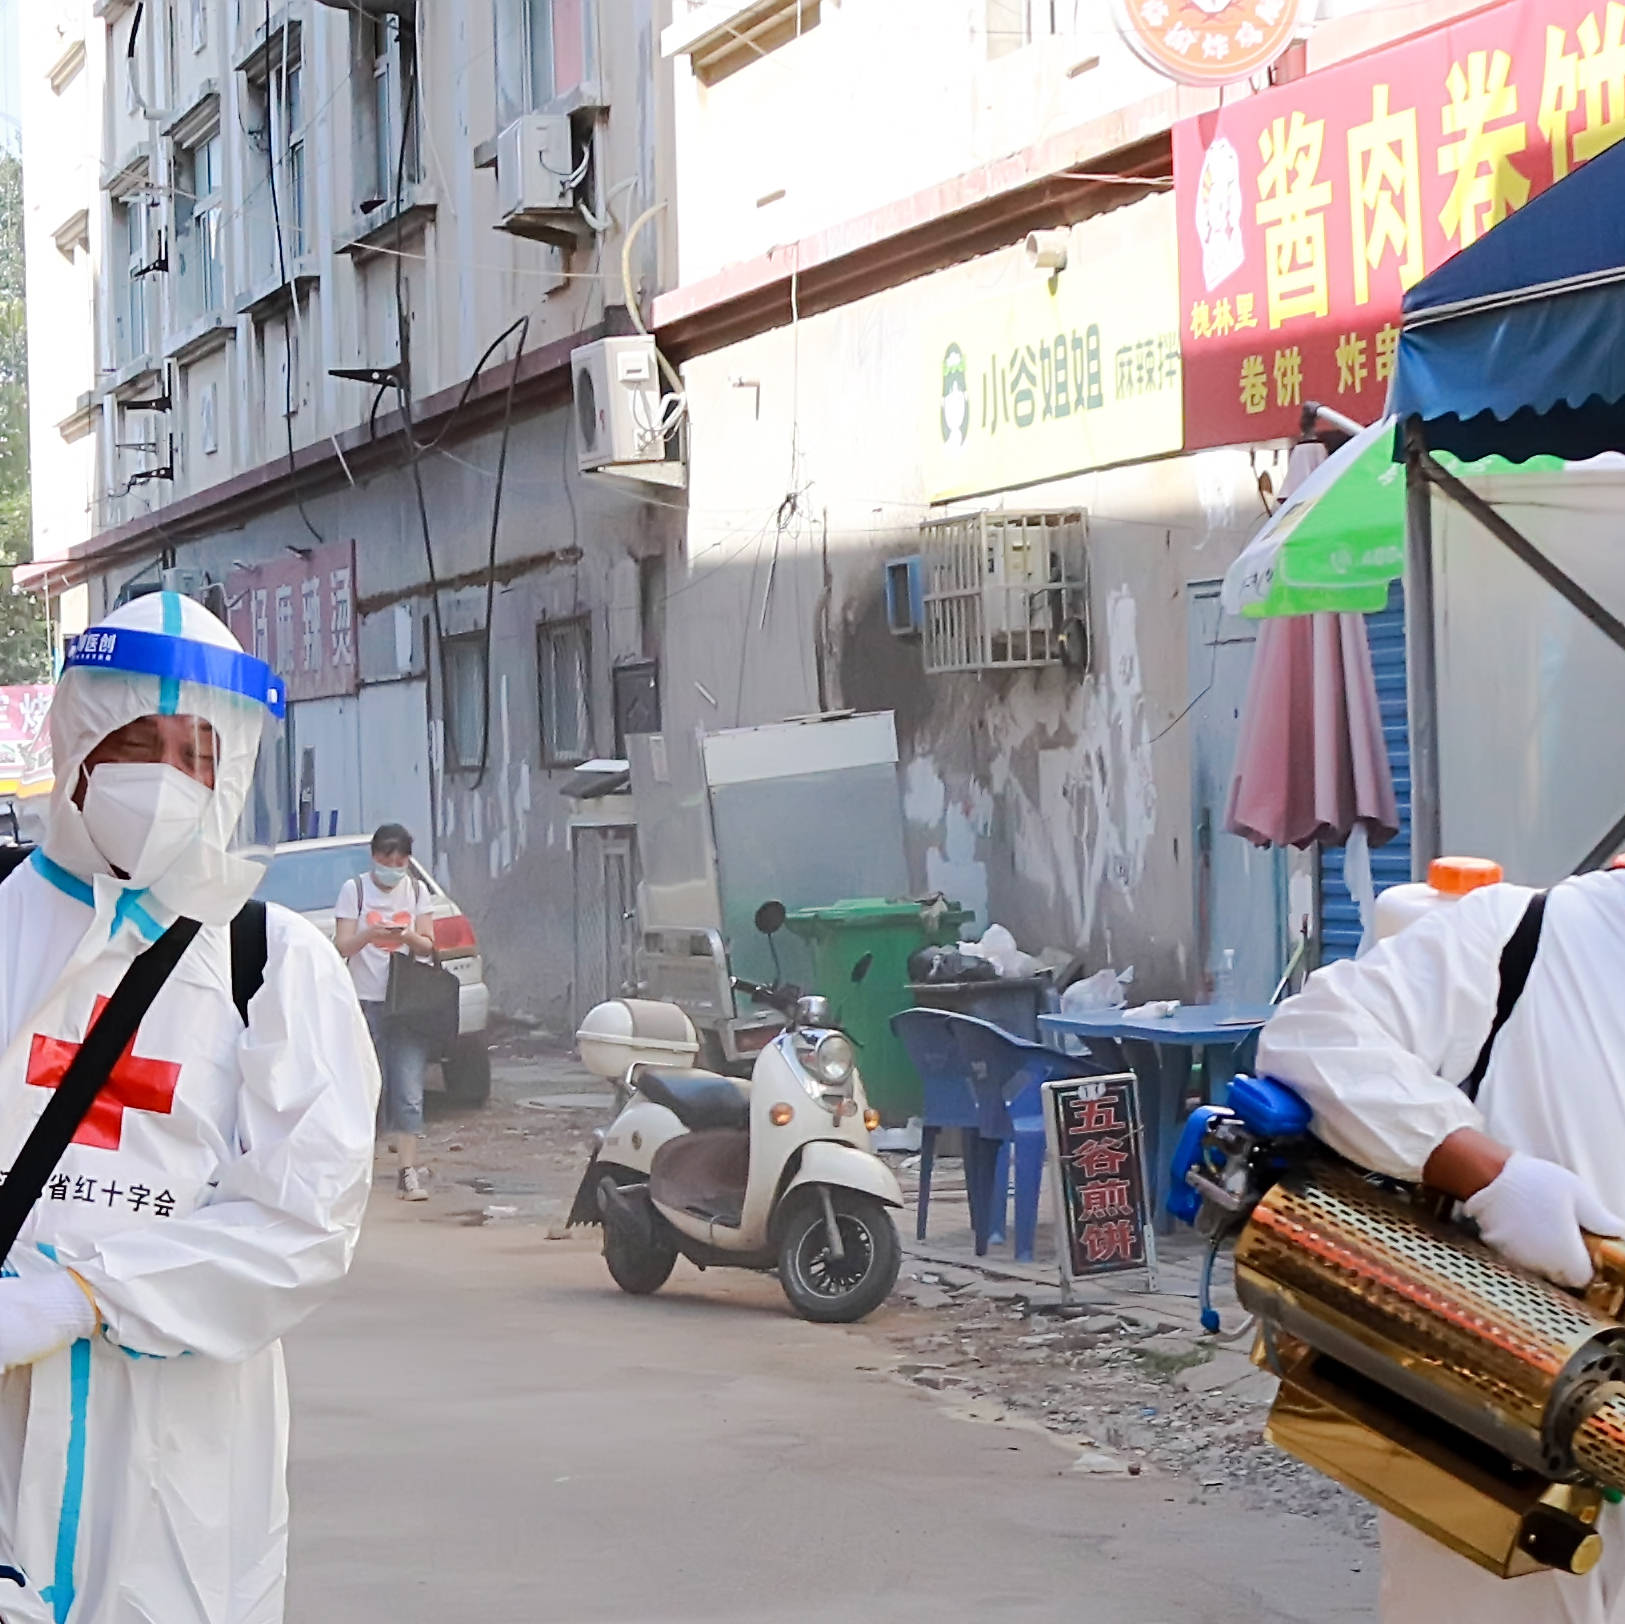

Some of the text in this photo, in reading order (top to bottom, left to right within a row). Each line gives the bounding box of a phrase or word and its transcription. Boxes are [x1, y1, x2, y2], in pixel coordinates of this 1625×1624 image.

[981, 322, 1104, 435] 小谷姐姐
[1239, 348, 1303, 415] 卷饼
[1068, 1096, 1138, 1262] 五谷煎饼
